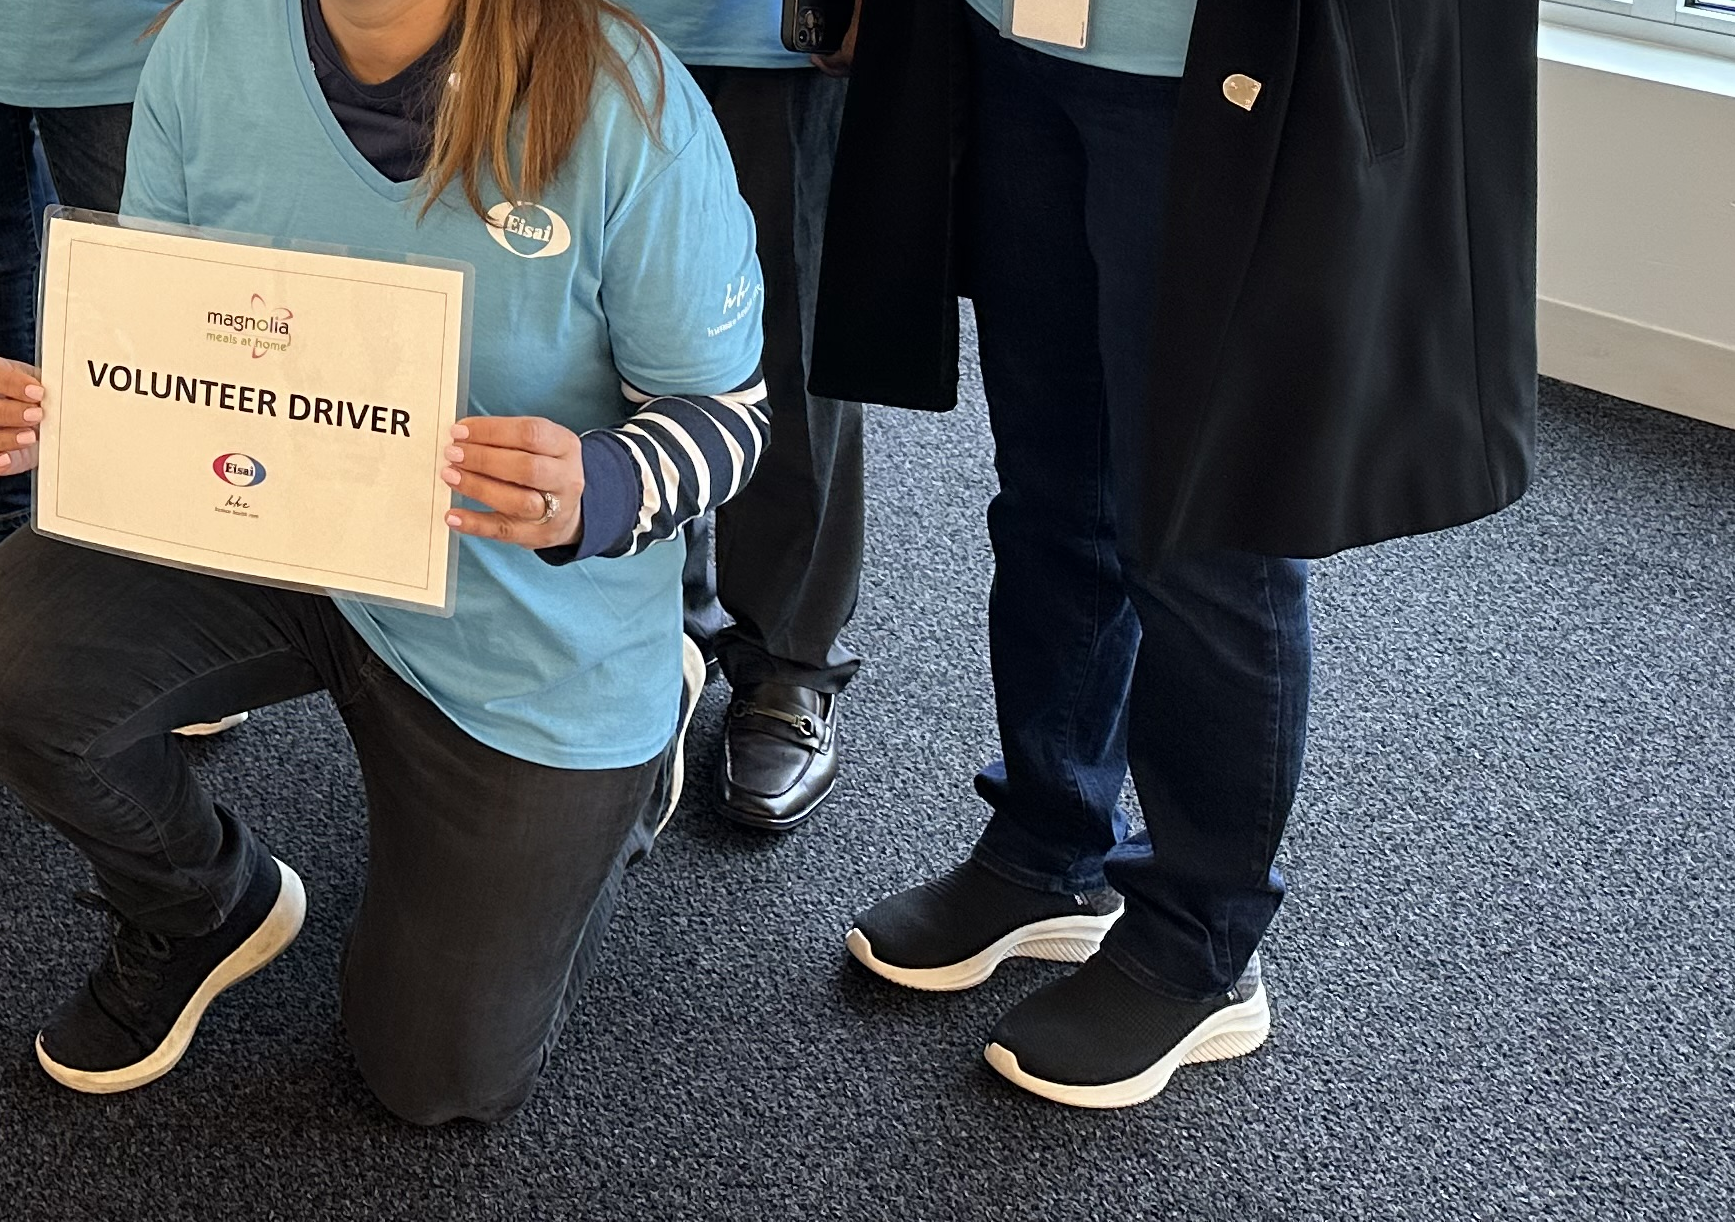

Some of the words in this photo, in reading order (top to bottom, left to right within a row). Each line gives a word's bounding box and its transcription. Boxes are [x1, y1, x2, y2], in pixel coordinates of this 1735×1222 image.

[505, 214, 553, 242] Eisai
[723, 276, 751, 314] hh
[207, 311, 289, 334] magnolia
[206, 333, 237, 344] meals
[241, 337, 251, 347] at
[255, 338, 287, 351] home
[87, 360, 277, 417] VOLUNTEER
[288, 393, 411, 437] DRIVER
[225, 463, 253, 477] Eisai
